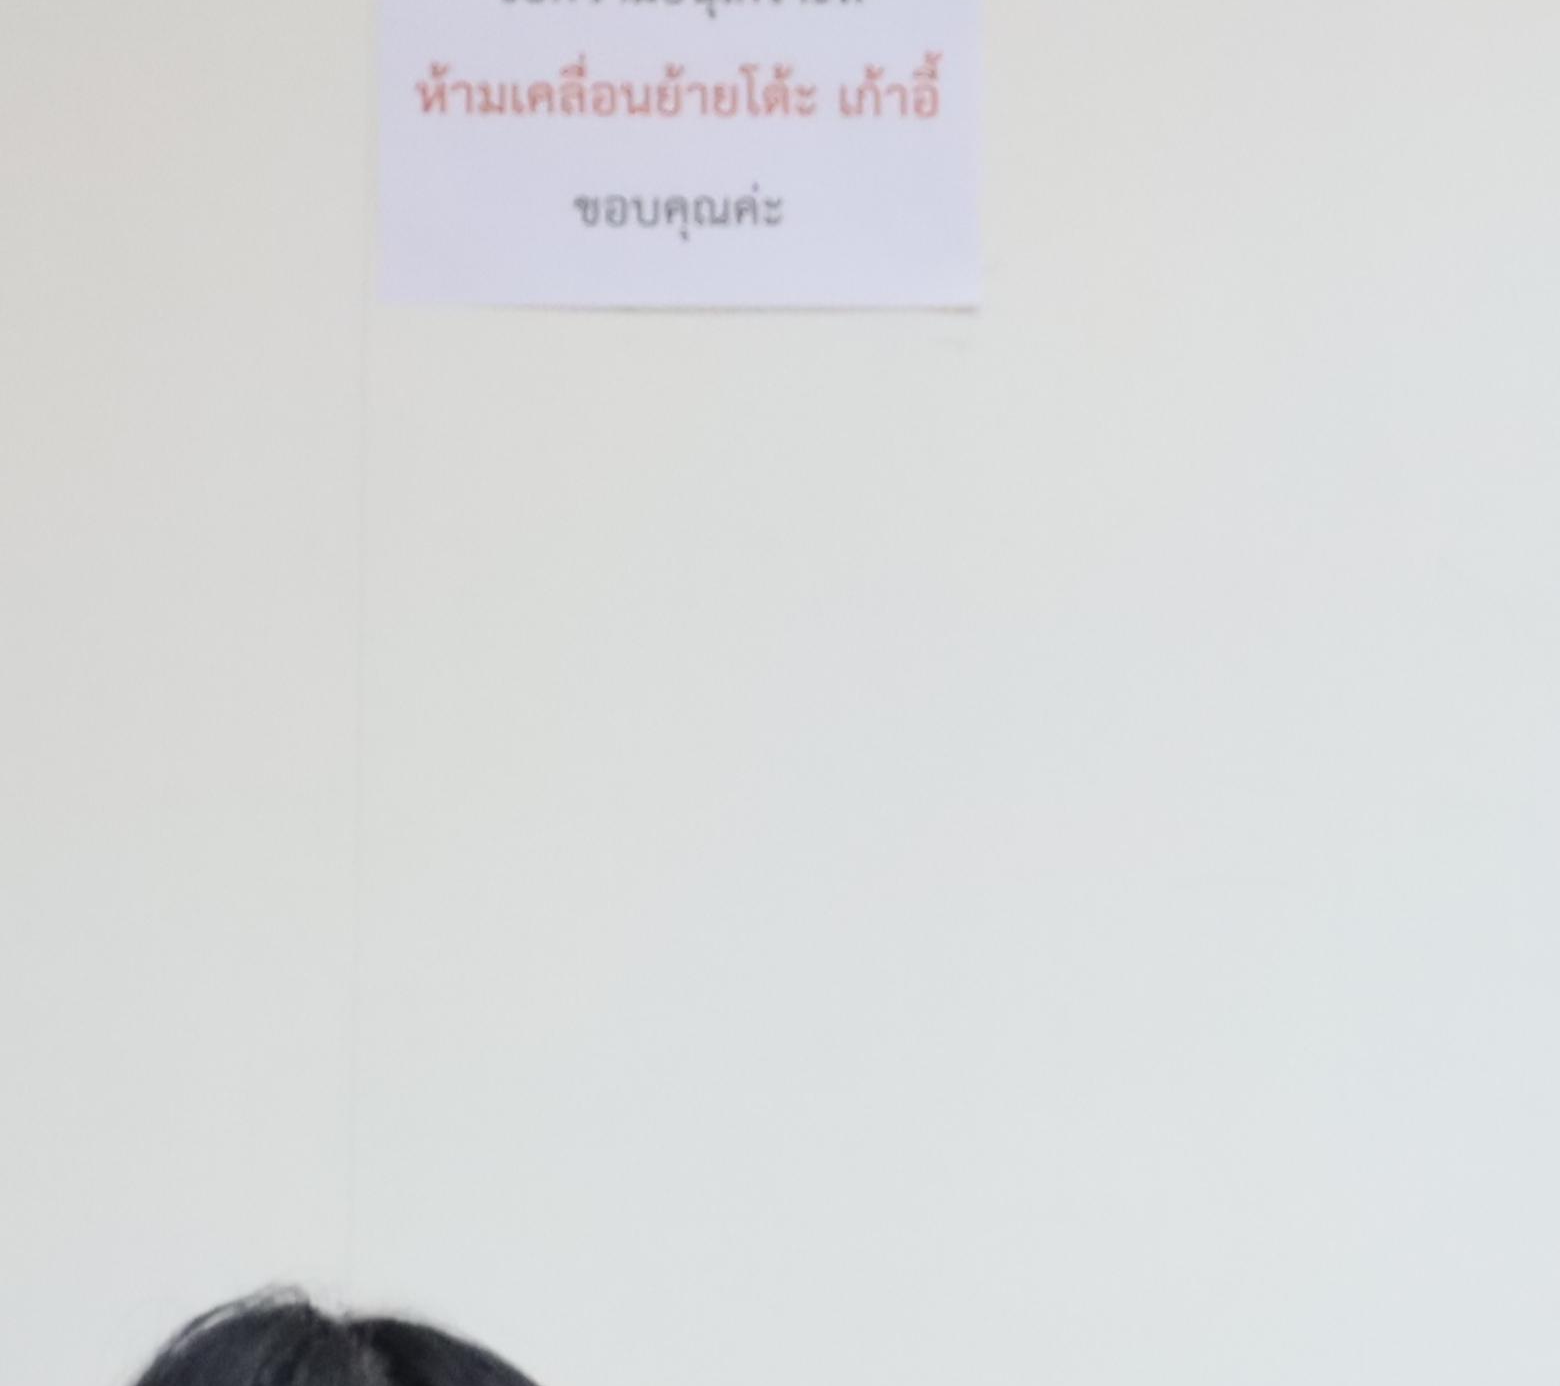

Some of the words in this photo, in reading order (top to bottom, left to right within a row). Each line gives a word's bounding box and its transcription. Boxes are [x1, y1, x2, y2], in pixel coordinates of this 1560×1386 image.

[837, 51, 944, 119] เก้าอี้
[572, 181, 784, 241] ขอบคุณค่ะ
